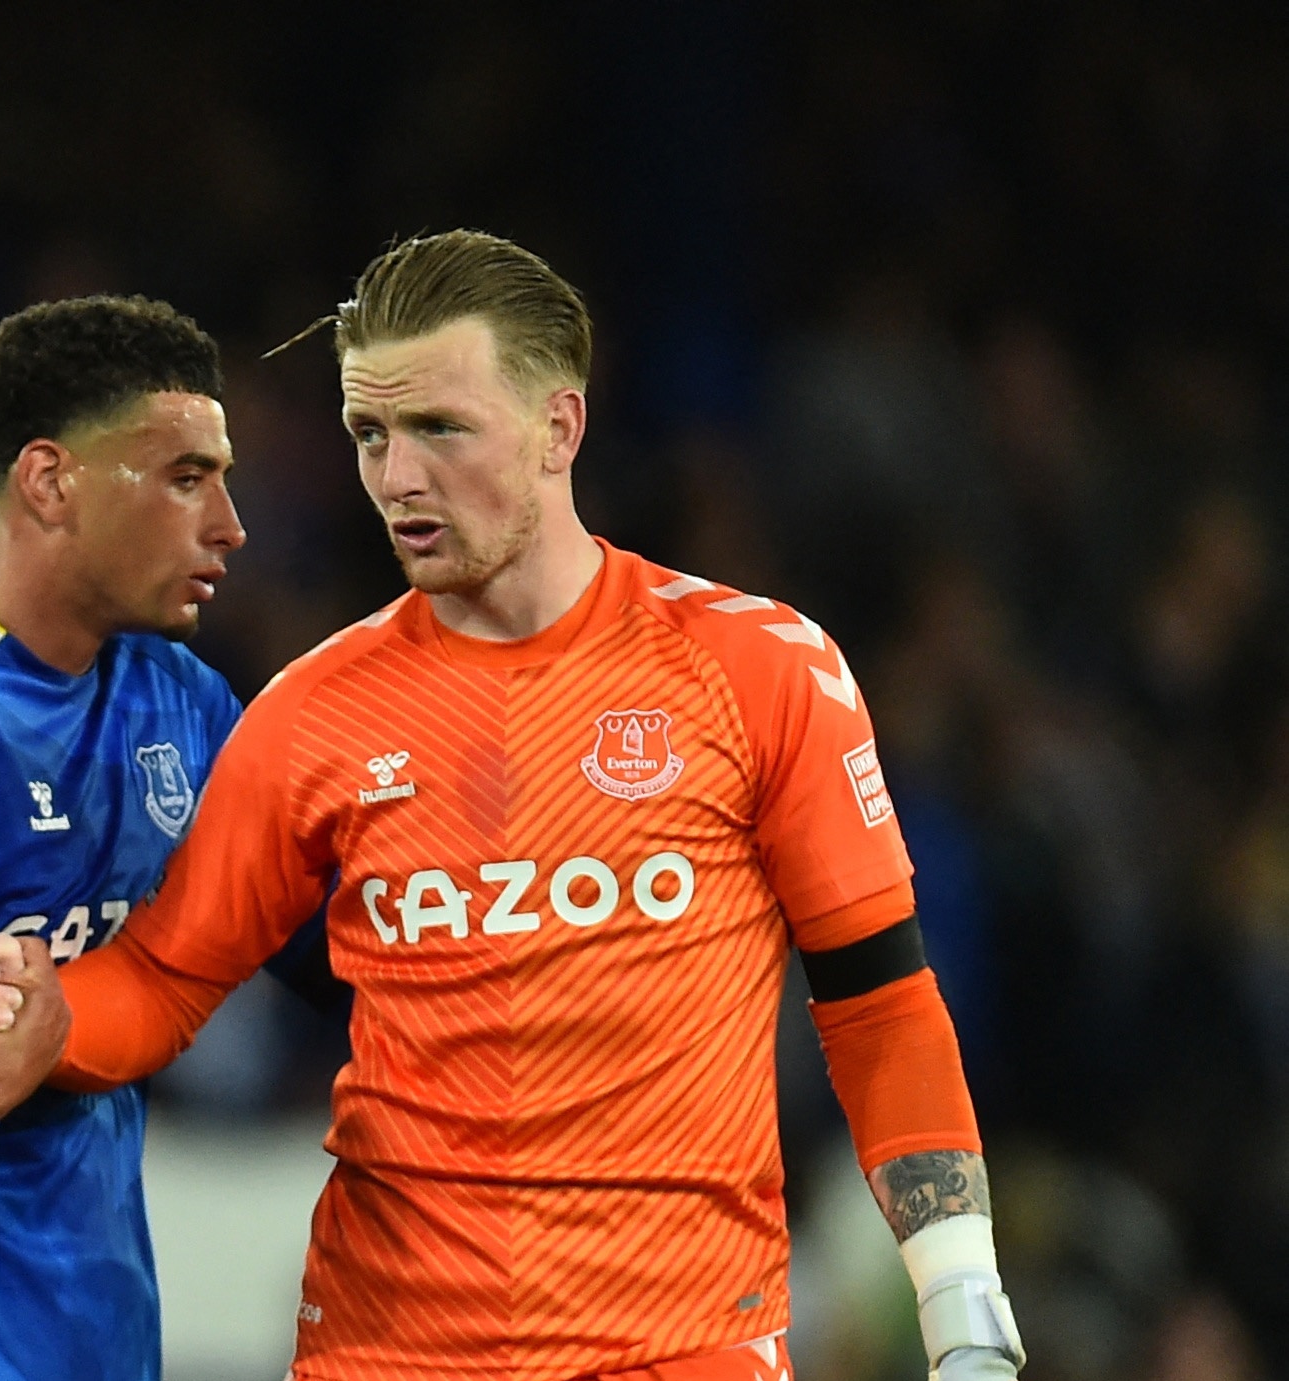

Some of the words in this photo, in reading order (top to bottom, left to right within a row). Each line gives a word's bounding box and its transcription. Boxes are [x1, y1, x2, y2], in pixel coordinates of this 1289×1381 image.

[606, 757, 659, 770] Everton
[358, 780, 416, 806] hummel
[361, 851, 695, 944] CAZOO
